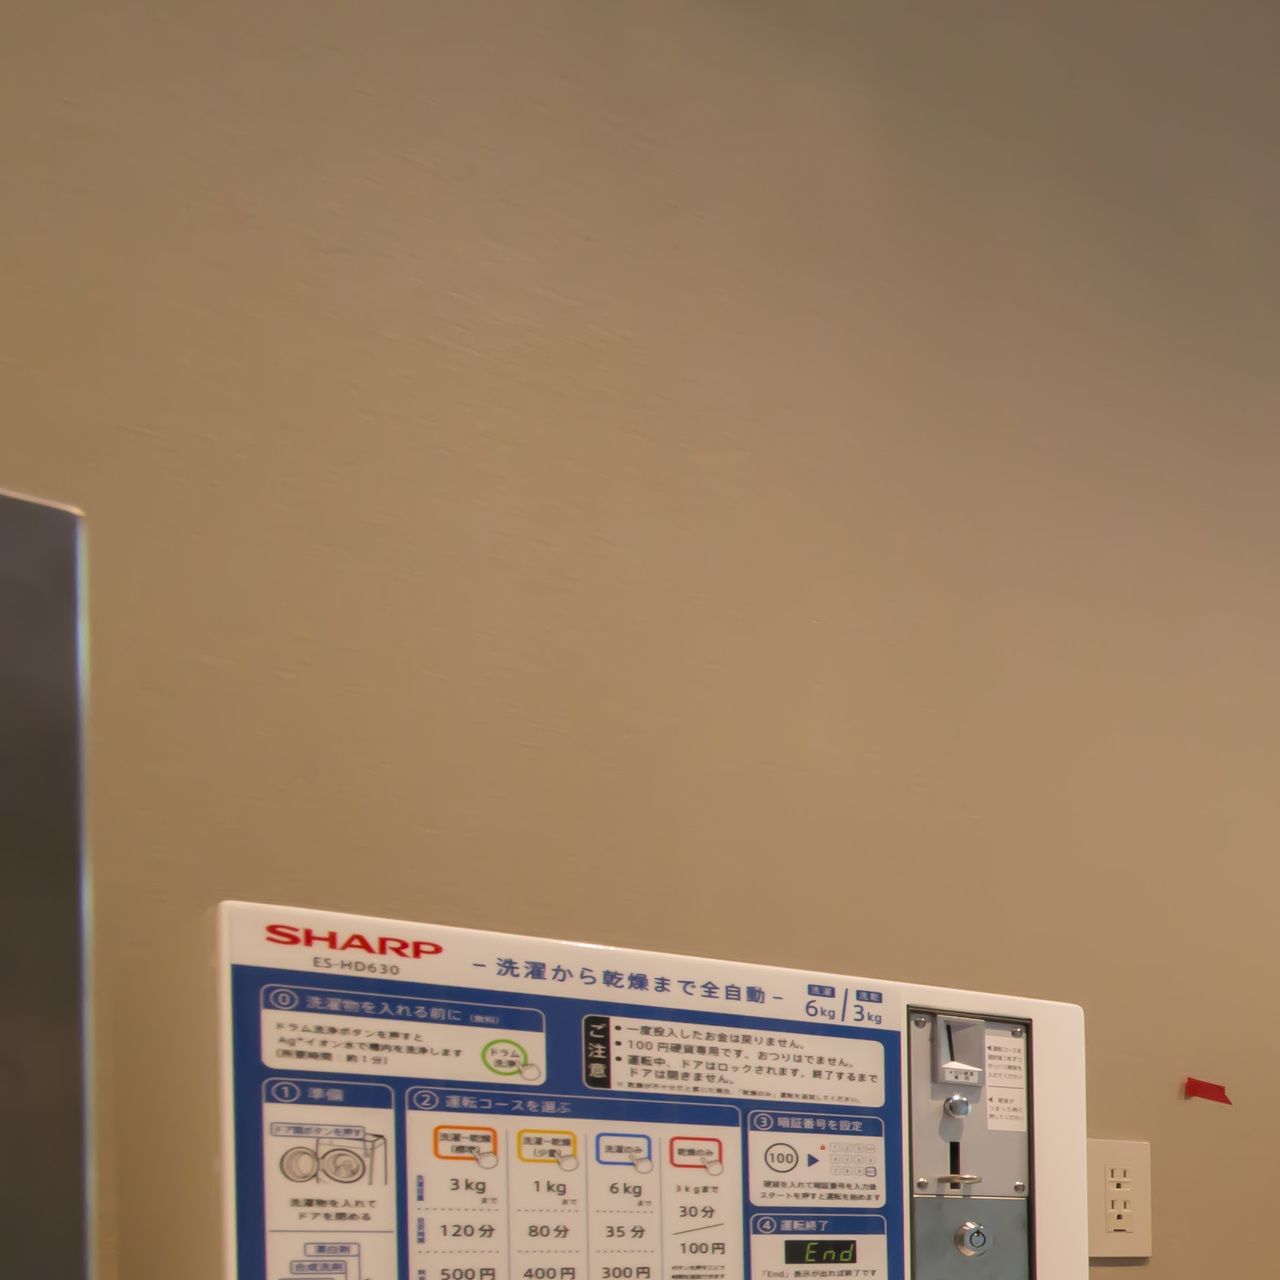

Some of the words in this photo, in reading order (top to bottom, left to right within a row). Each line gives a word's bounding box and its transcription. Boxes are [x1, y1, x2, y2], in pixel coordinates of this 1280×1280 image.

[265, 923, 443, 959] SHARP
[313, 956, 400, 976] ES-HD630
[496, 957, 766, 1004] 洗濯から乾燥まで全自動
[306, 995, 462, 1021] 洗濯物を入れる前に
[308, 1087, 344, 1102] 準備
[445, 1095, 572, 1114] 運転コースを選ぶ
[777, 1117, 863, 1132] 暗証番号を設定
[769, 1153, 794, 1164] 100
[780, 1220, 829, 1231] 運転終了
[805, 1242, 854, 1262] End
